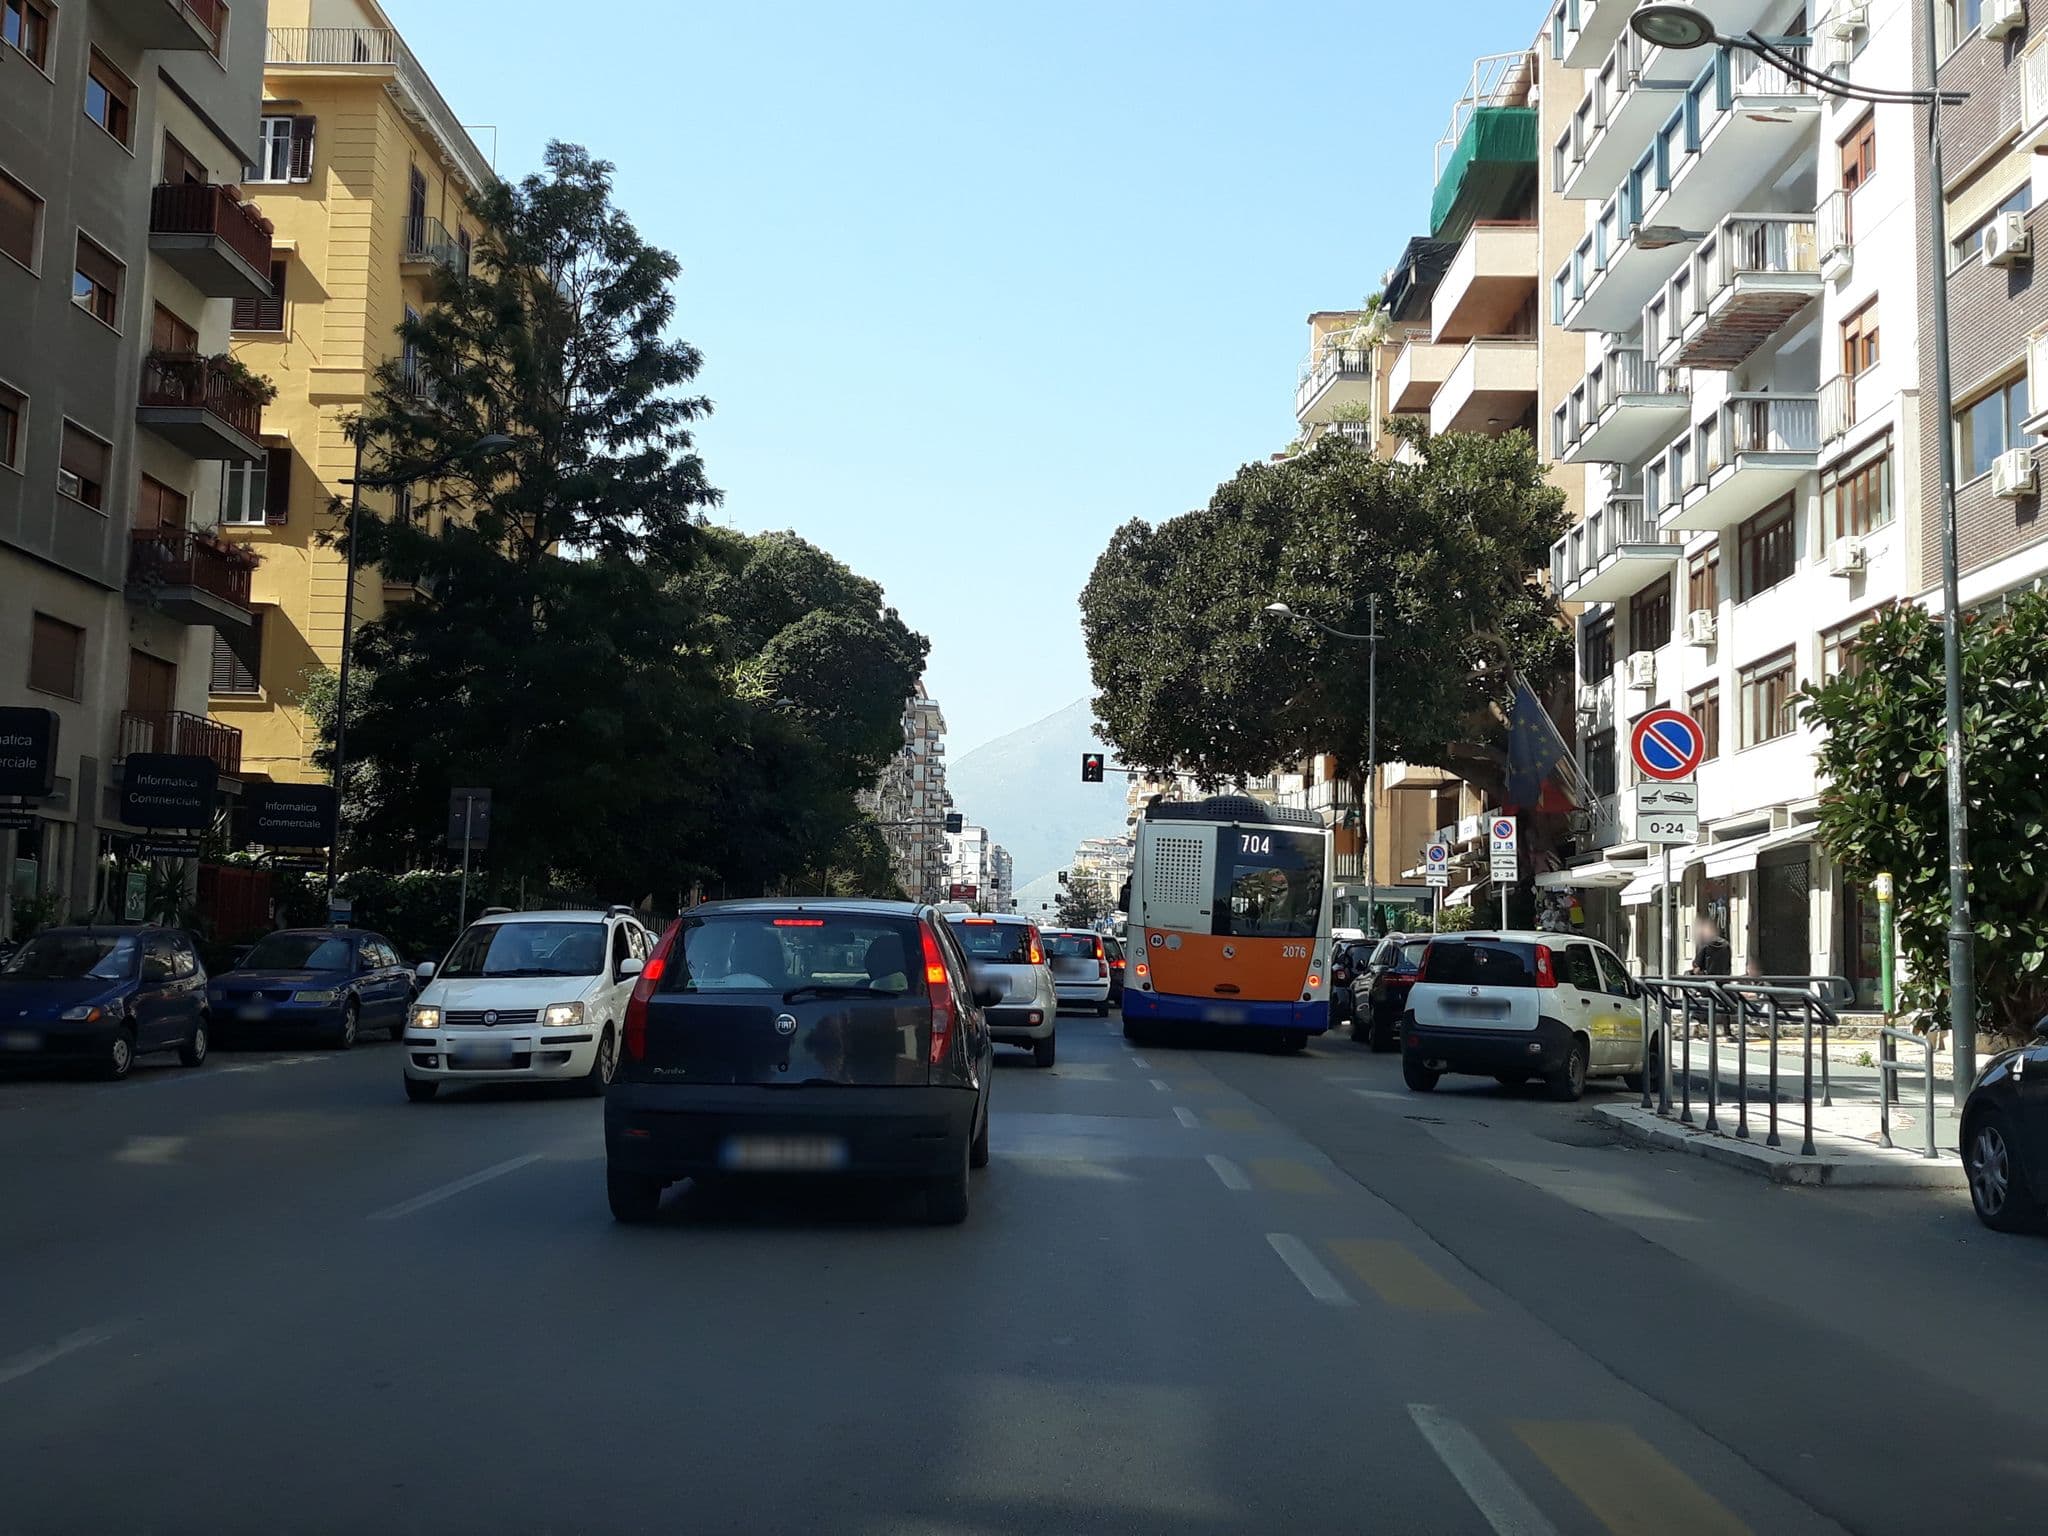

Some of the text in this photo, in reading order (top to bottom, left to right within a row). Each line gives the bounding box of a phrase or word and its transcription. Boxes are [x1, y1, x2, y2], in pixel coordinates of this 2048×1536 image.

[0, 734, 33, 746] atica
[0, 755, 38, 769] rciale
[137, 773, 198, 788] Informatica
[129, 792, 201, 807] Commerciale
[265, 801, 318, 812] Informatica
[258, 816, 321, 829] Commerciale
[1650, 822, 1684, 834] 0-24
[1241, 834, 1270, 854] 704
[1282, 945, 1307, 958] 2076
